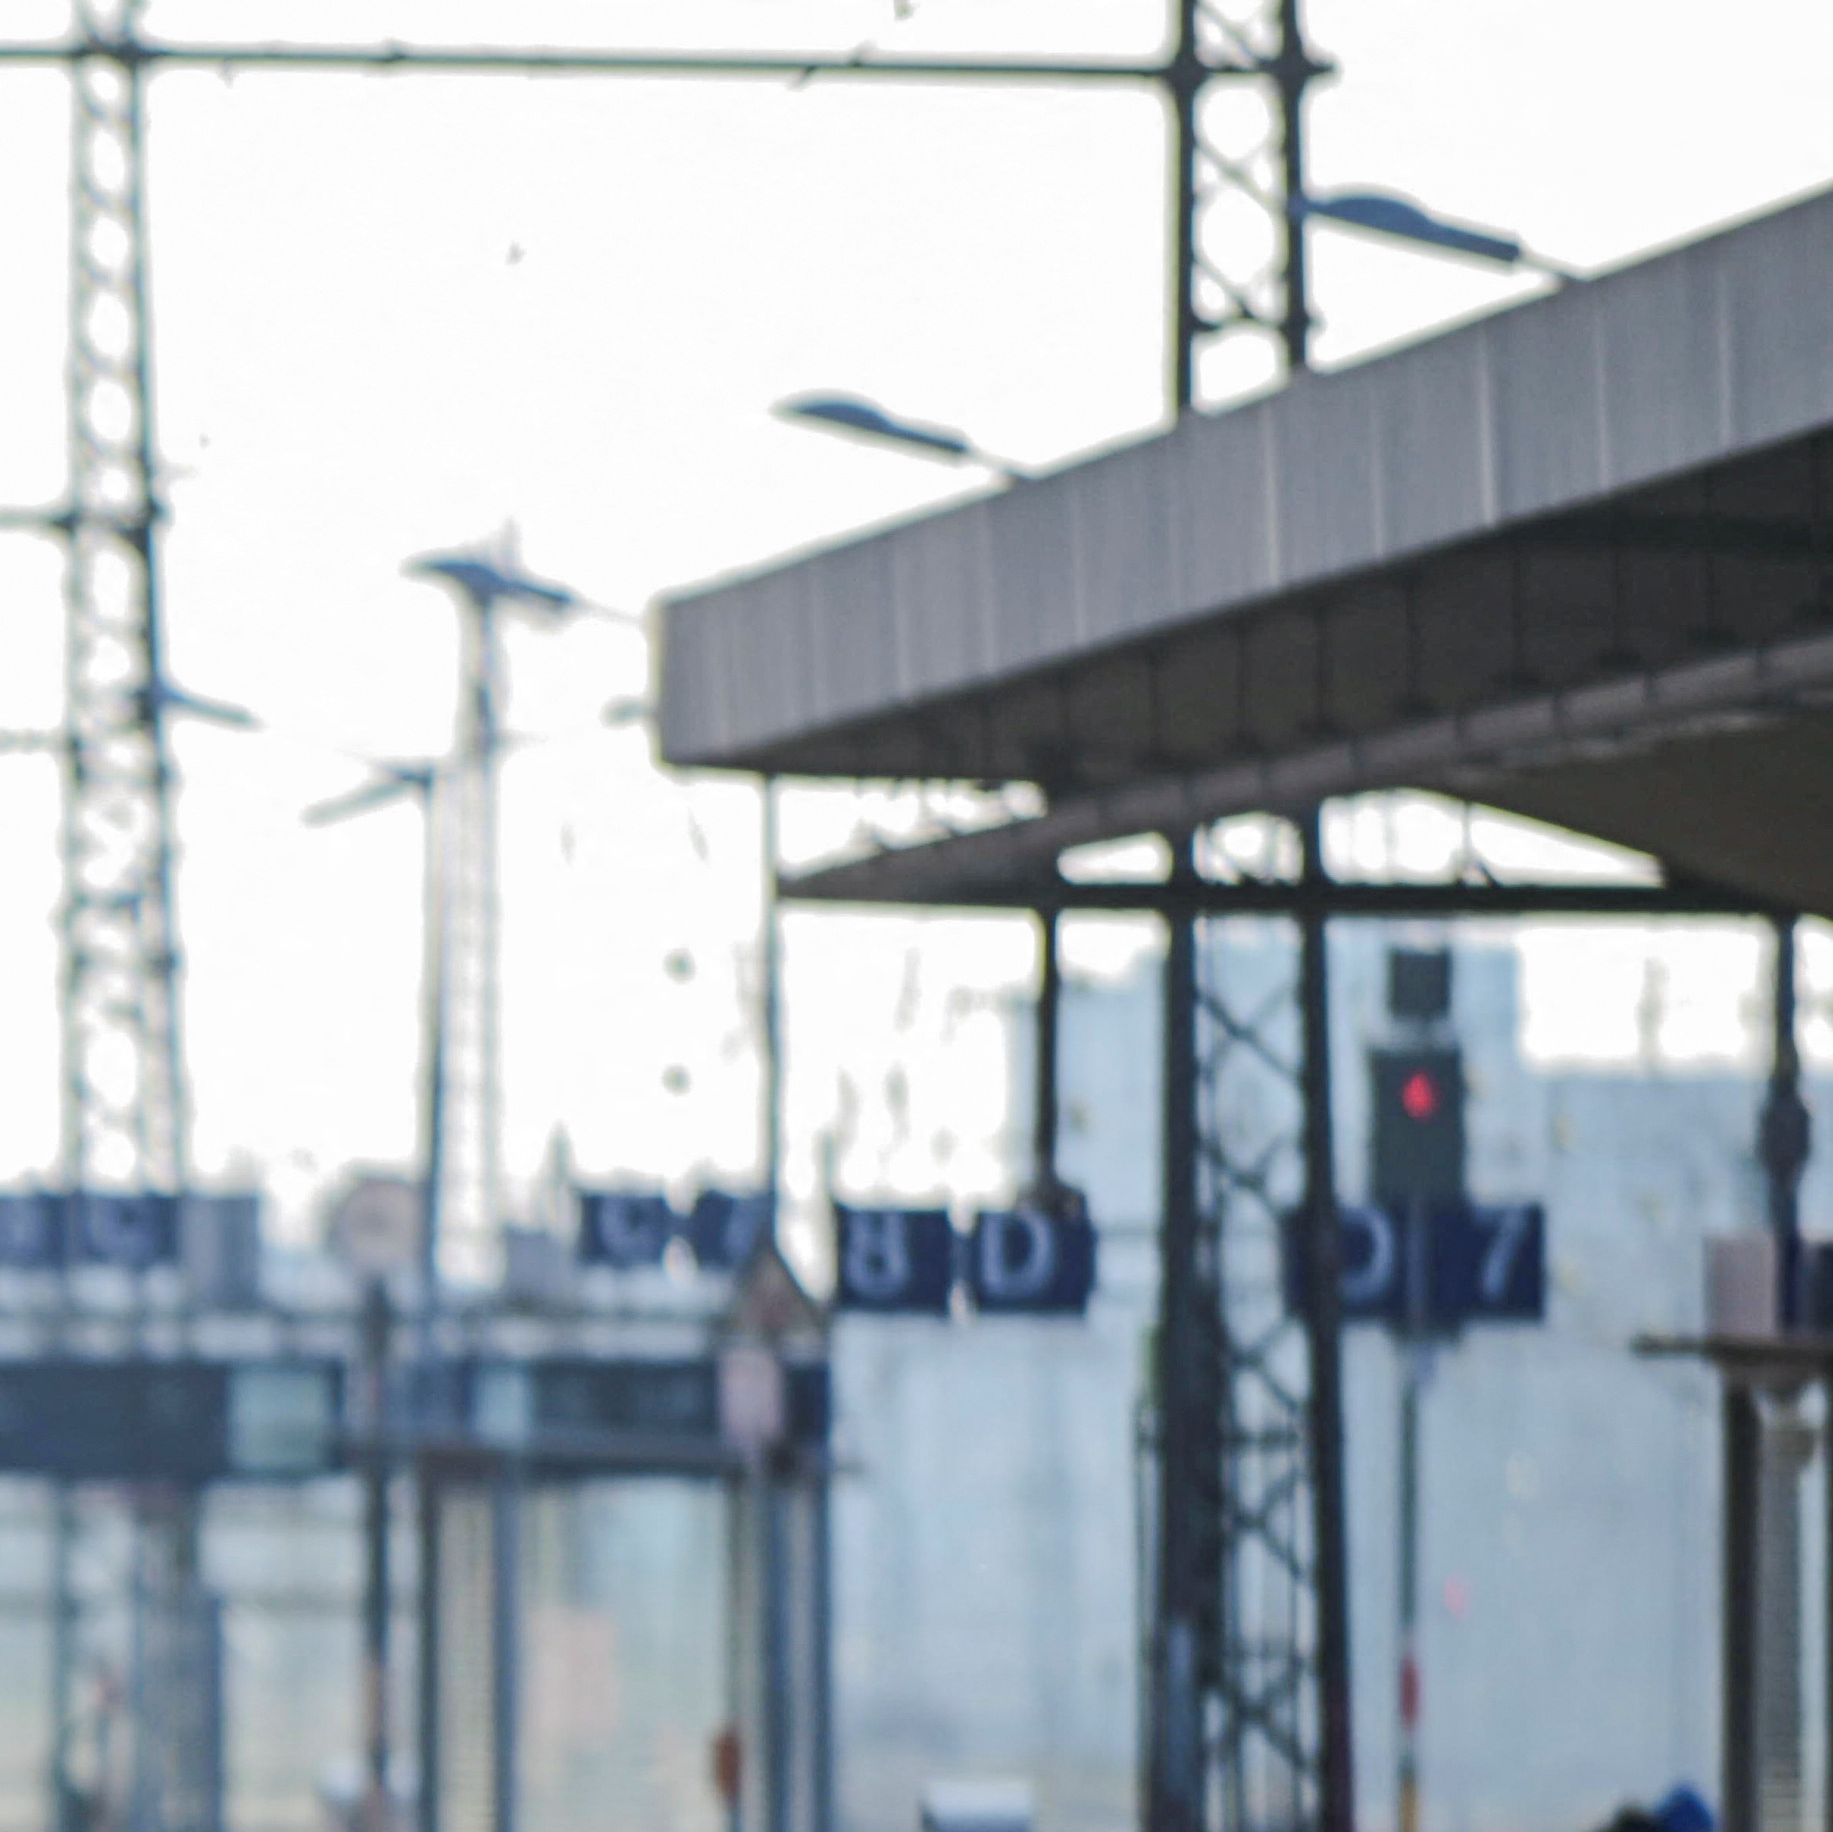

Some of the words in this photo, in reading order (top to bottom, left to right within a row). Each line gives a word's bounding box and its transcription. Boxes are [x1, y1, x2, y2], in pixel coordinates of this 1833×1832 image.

[845, 1210, 907, 1300] 8
[981, 1209, 1054, 1299] D
[1475, 1205, 1528, 1300] 7
